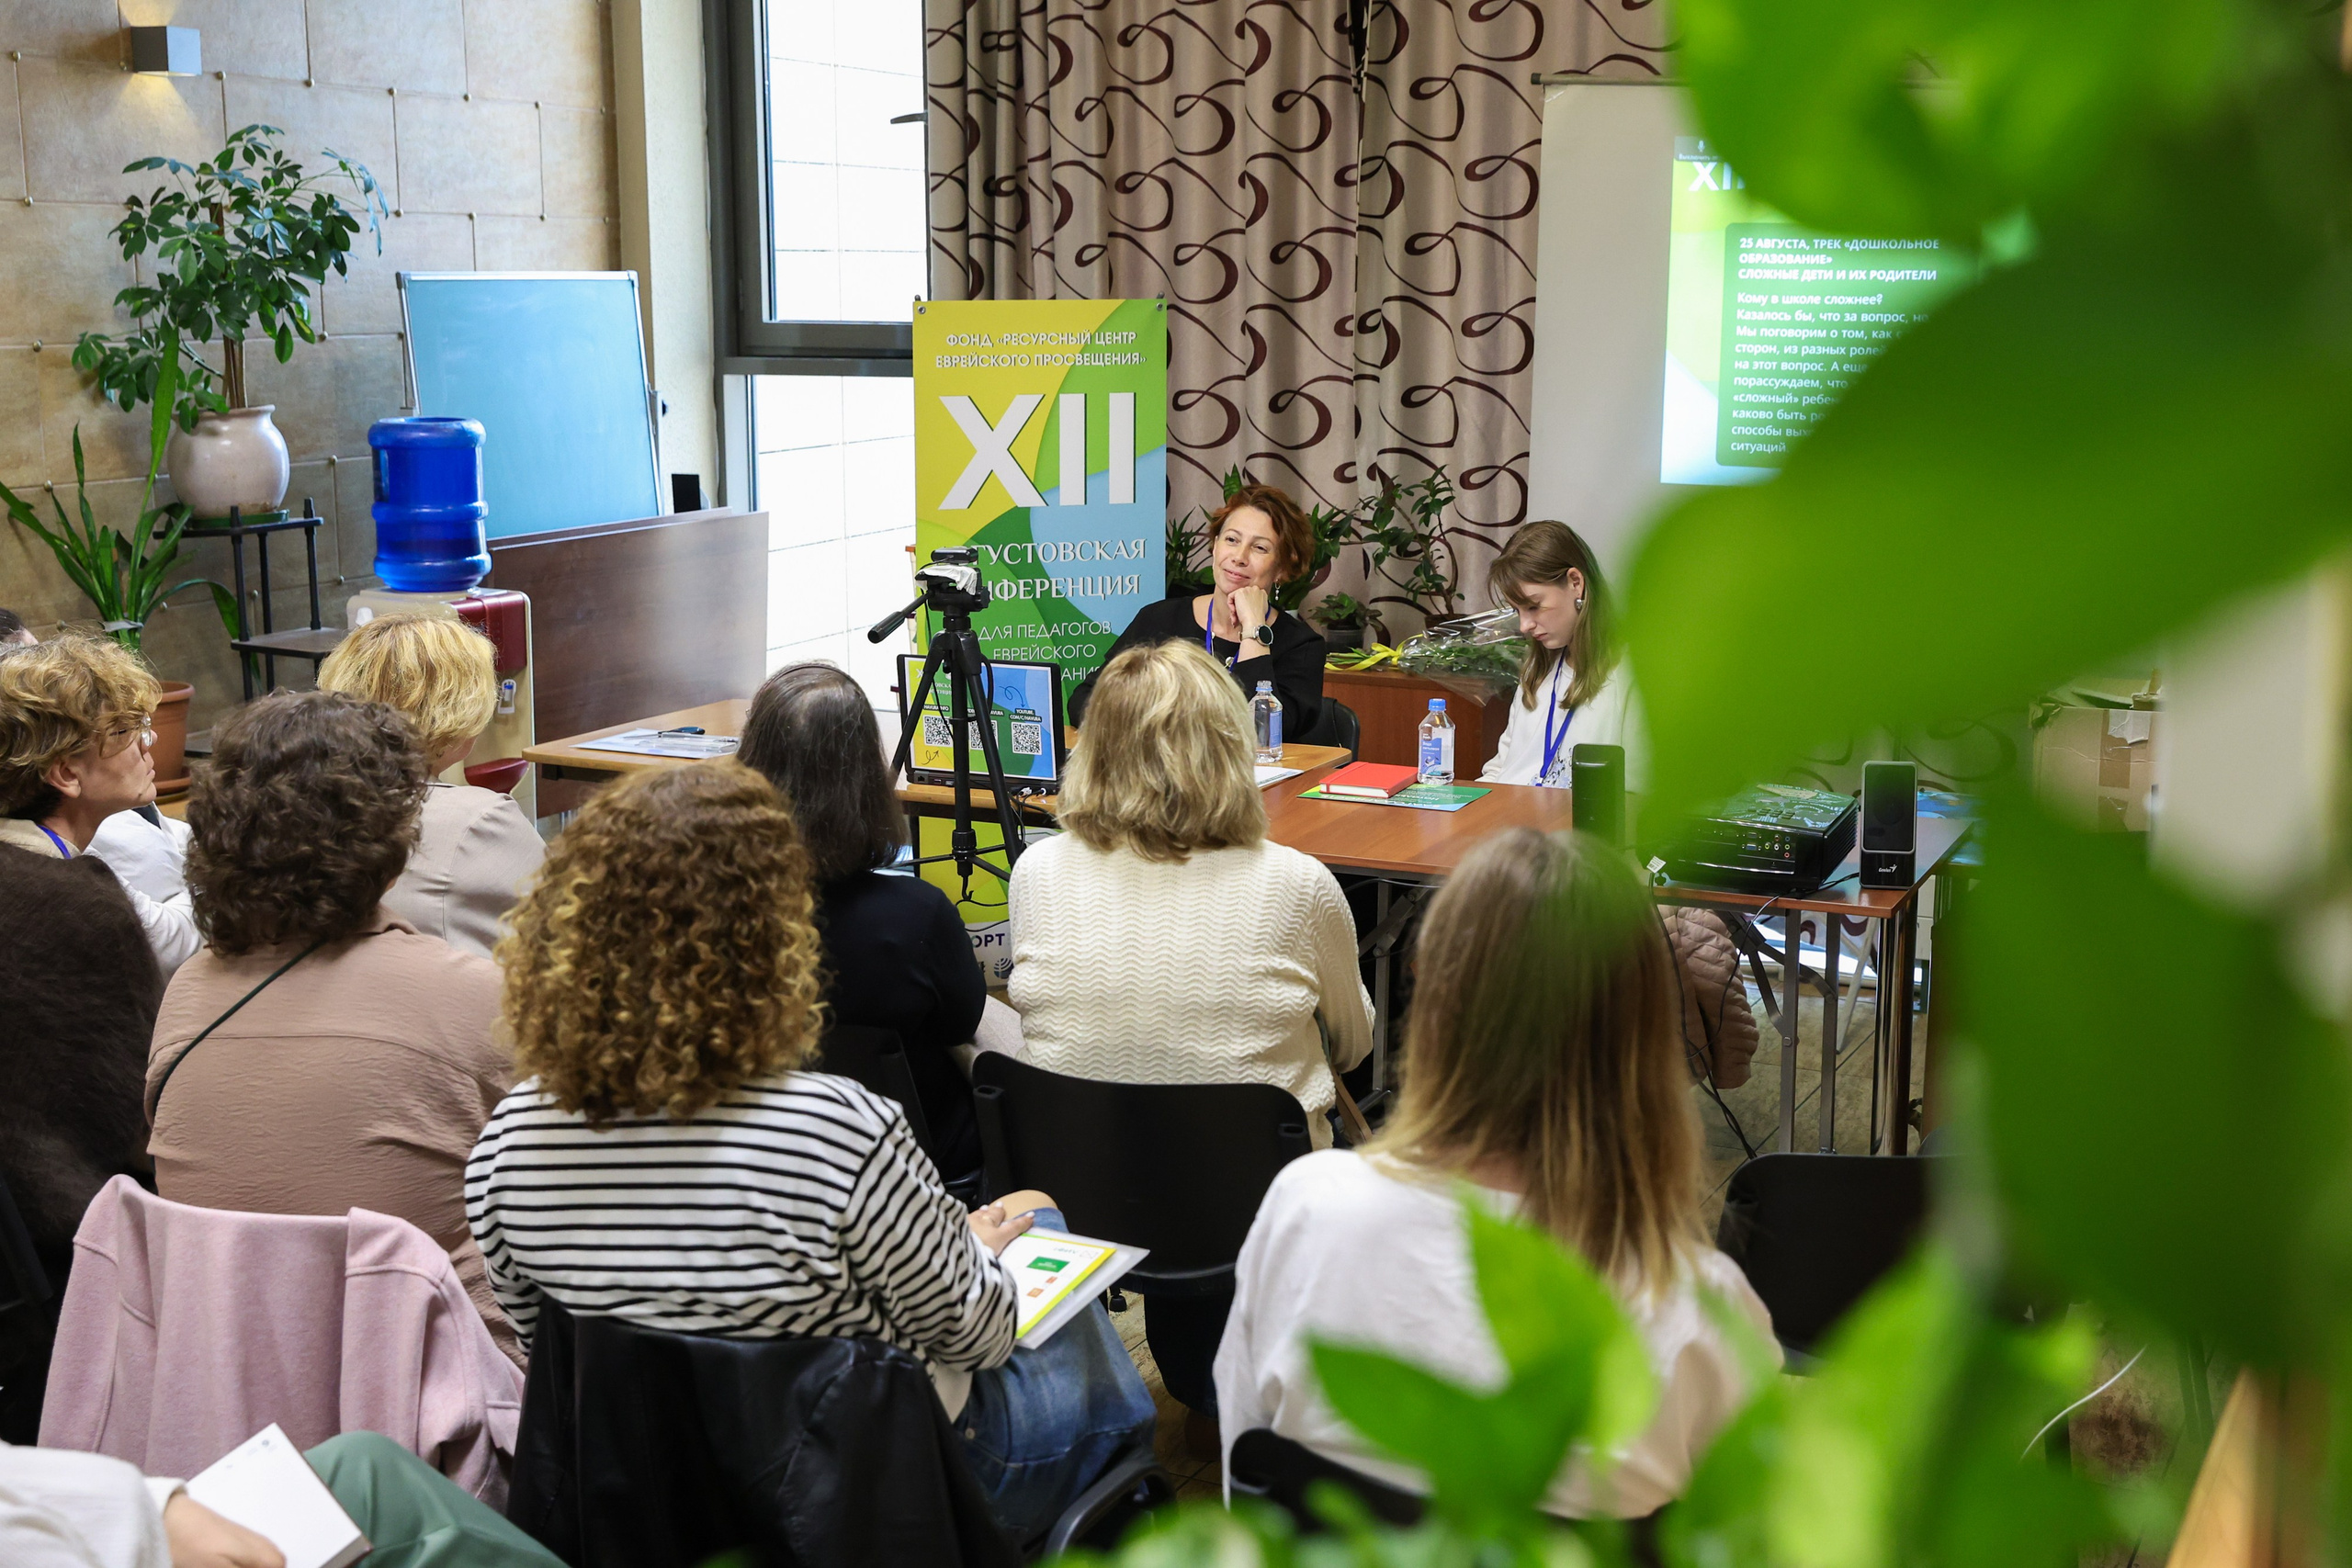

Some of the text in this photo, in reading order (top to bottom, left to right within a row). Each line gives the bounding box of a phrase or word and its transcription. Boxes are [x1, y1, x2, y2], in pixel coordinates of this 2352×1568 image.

[1688, 162, 1746, 191] XI
[1739, 238, 1939, 252] 25 АВГУСТА, ТРЕК «ДОШКОЛЬНОЕ
[1738, 254, 1833, 265] ОБРАЗОВАНИЕ»
[1737, 268, 1937, 283] СЛОЖНЫЕ ДЕТИ И ИХ РОДИТЕЛИ
[1737, 292, 1883, 306] Кому в школе сложнее?
[1736, 309, 1792, 320] Казалось
[1794, 310, 1815, 323] бы,
[1819, 312, 1840, 321] что
[1844, 312, 1857, 321] за
[1860, 312, 1908, 325] вопрос,
[946, 329, 1137, 347] ФОНД «РЕСУРСНЫЙ ЦЕНТР
[1736, 325, 1757, 336] Мы
[1759, 328, 1826, 340] поговорим
[1829, 329, 1838, 339] о
[1841, 329, 1868, 340] том,
[1871, 330, 1893, 339] как
[1735, 343, 1781, 355] сторон,
[1783, 344, 1798, 355] из
[1801, 345, 1846, 357] разных
[935, 351, 1147, 368] ЕВРЕЙСКОГО ПРОСВЕЩЕНИЯ»
[1734, 359, 1749, 369] на
[1752, 360, 1777, 370] этот
[1781, 361, 1826, 373] вопрос.
[1830, 361, 1840, 371] А
[1733, 376, 1849, 389] порассуждаем, что
[1733, 392, 1799, 404] «сложный»
[1732, 409, 1773, 420] каково
[1776, 409, 1806, 420] быть
[1731, 424, 1781, 436] способы
[937, 392, 1136, 510] XII
[958, 538, 1147, 566] ГУСТОВСКАЯ
[988, 574, 1142, 601] ФЕРЕНЦИЯ
[978, 620, 1112, 641] ДЛЯ ПЕДАГОГОВ
[993, 643, 1097, 661] ЕВРЕЙСКОГО
